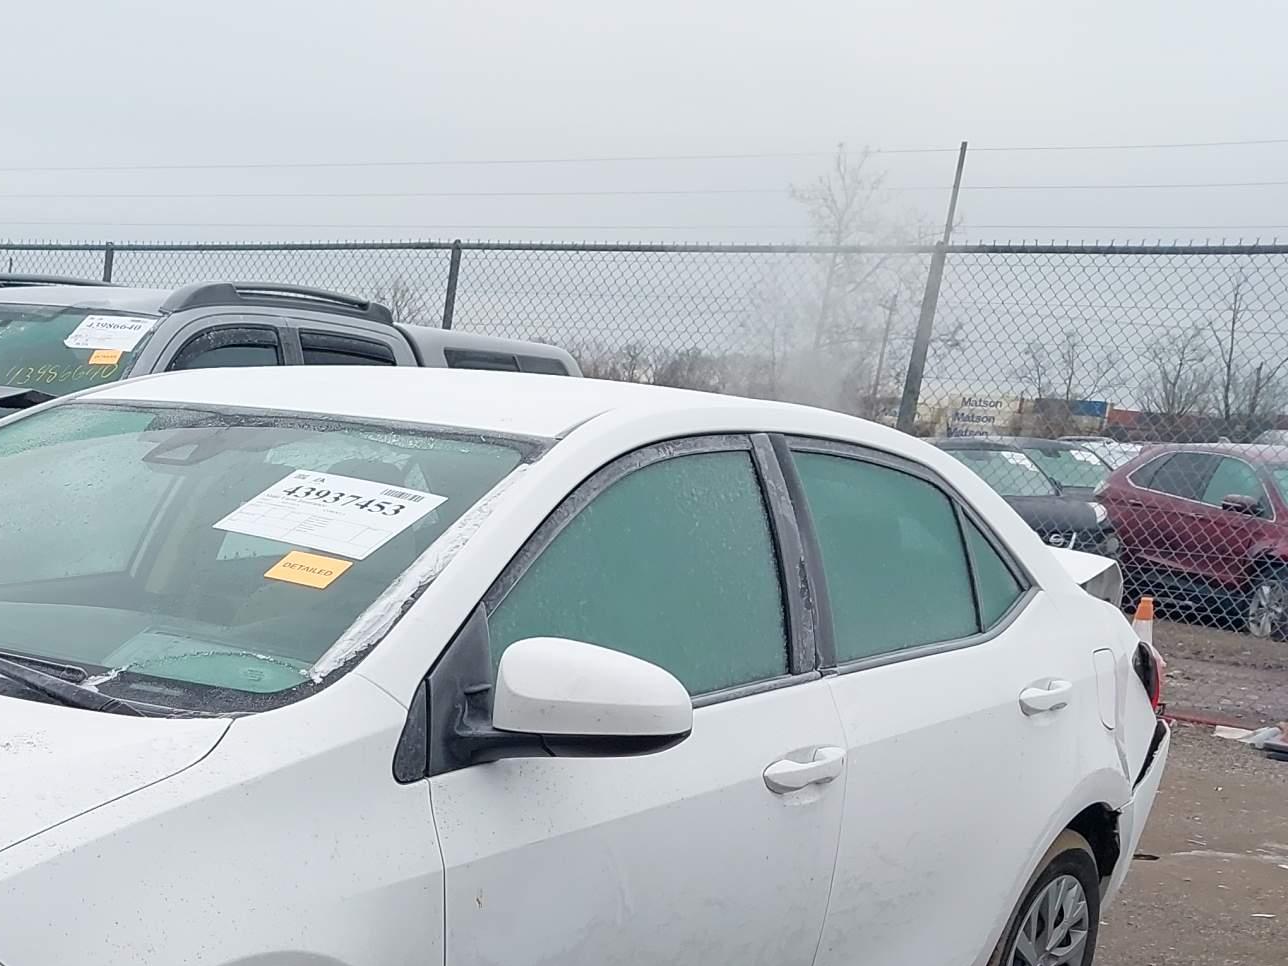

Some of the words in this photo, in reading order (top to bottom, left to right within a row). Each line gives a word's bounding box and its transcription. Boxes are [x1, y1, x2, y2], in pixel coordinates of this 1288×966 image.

[962, 397, 1002, 408] Matson
[953, 412, 995, 423] Matson
[283, 485, 406, 516] 43937453
[282, 561, 333, 577] DETAILED
